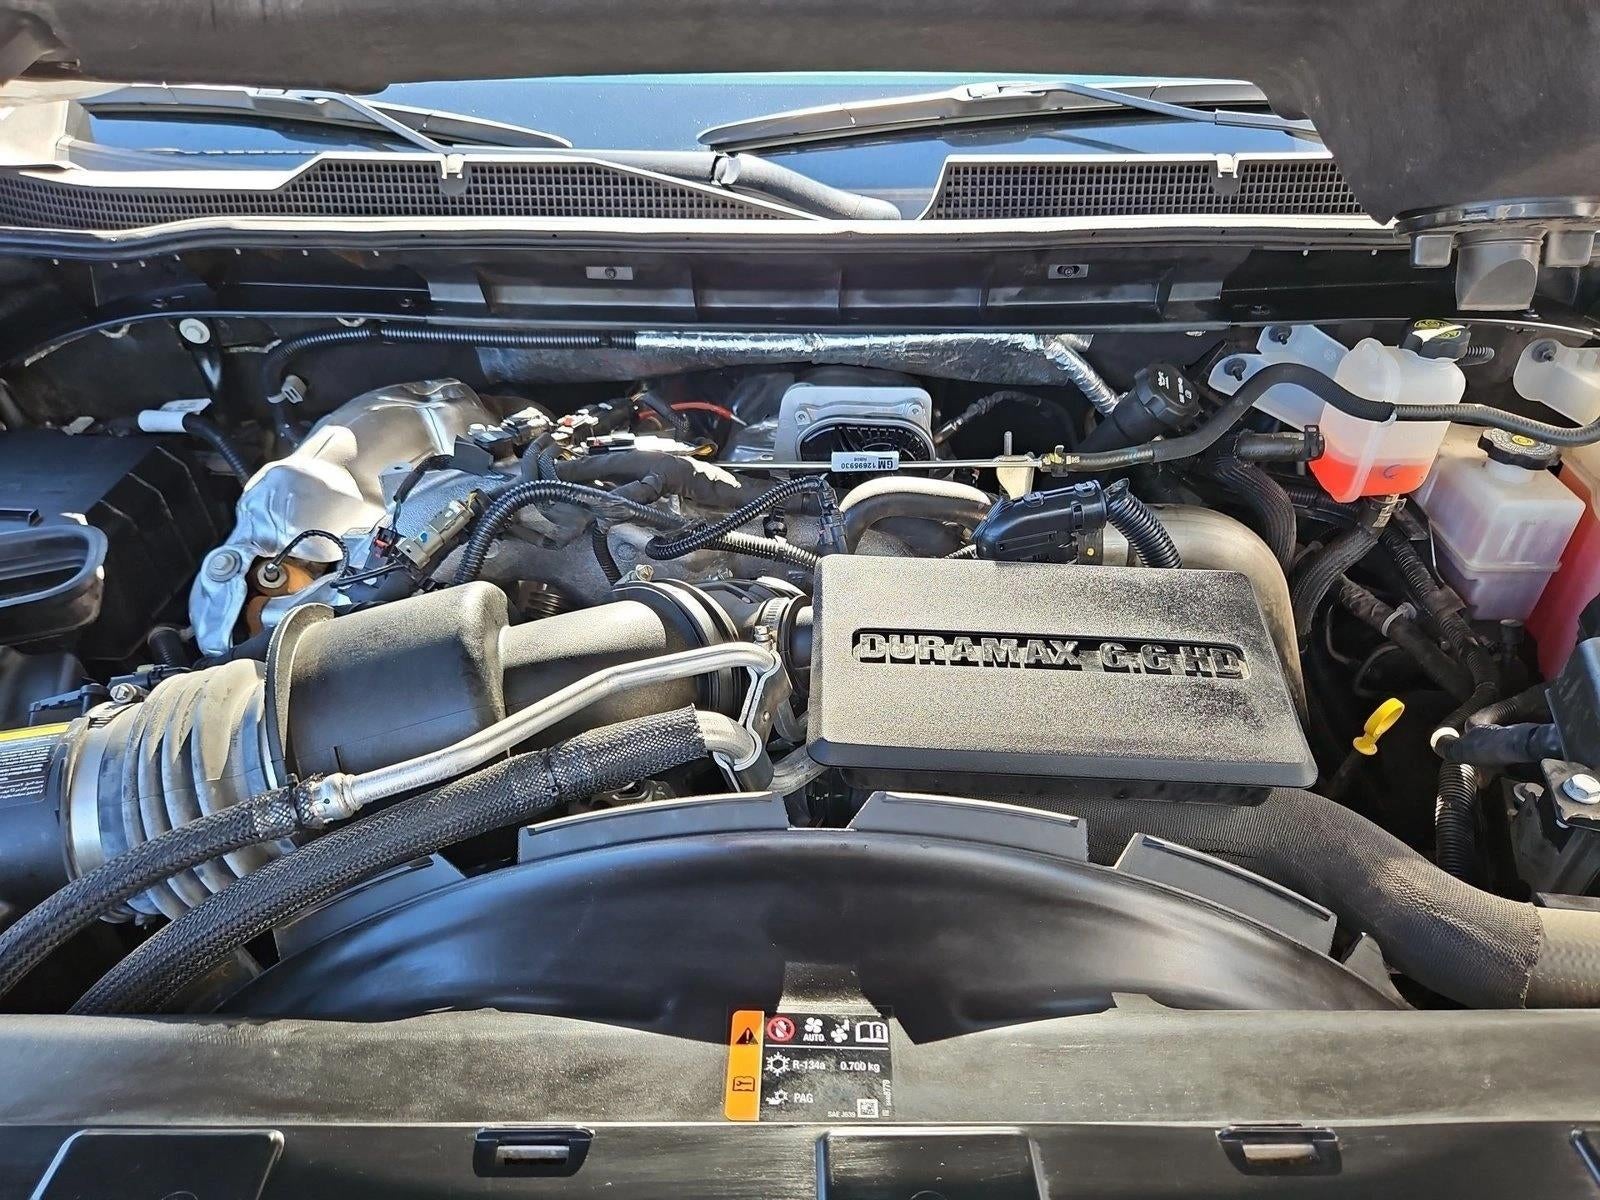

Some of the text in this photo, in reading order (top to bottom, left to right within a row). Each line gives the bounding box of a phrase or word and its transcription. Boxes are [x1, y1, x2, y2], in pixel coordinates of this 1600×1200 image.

[878, 460, 893, 469] GM
[859, 633, 1242, 678] DURAMAX 6.6 HD
[792, 1061, 881, 1073] R-134a 0.700 kg
[793, 1093, 814, 1103] PAG
